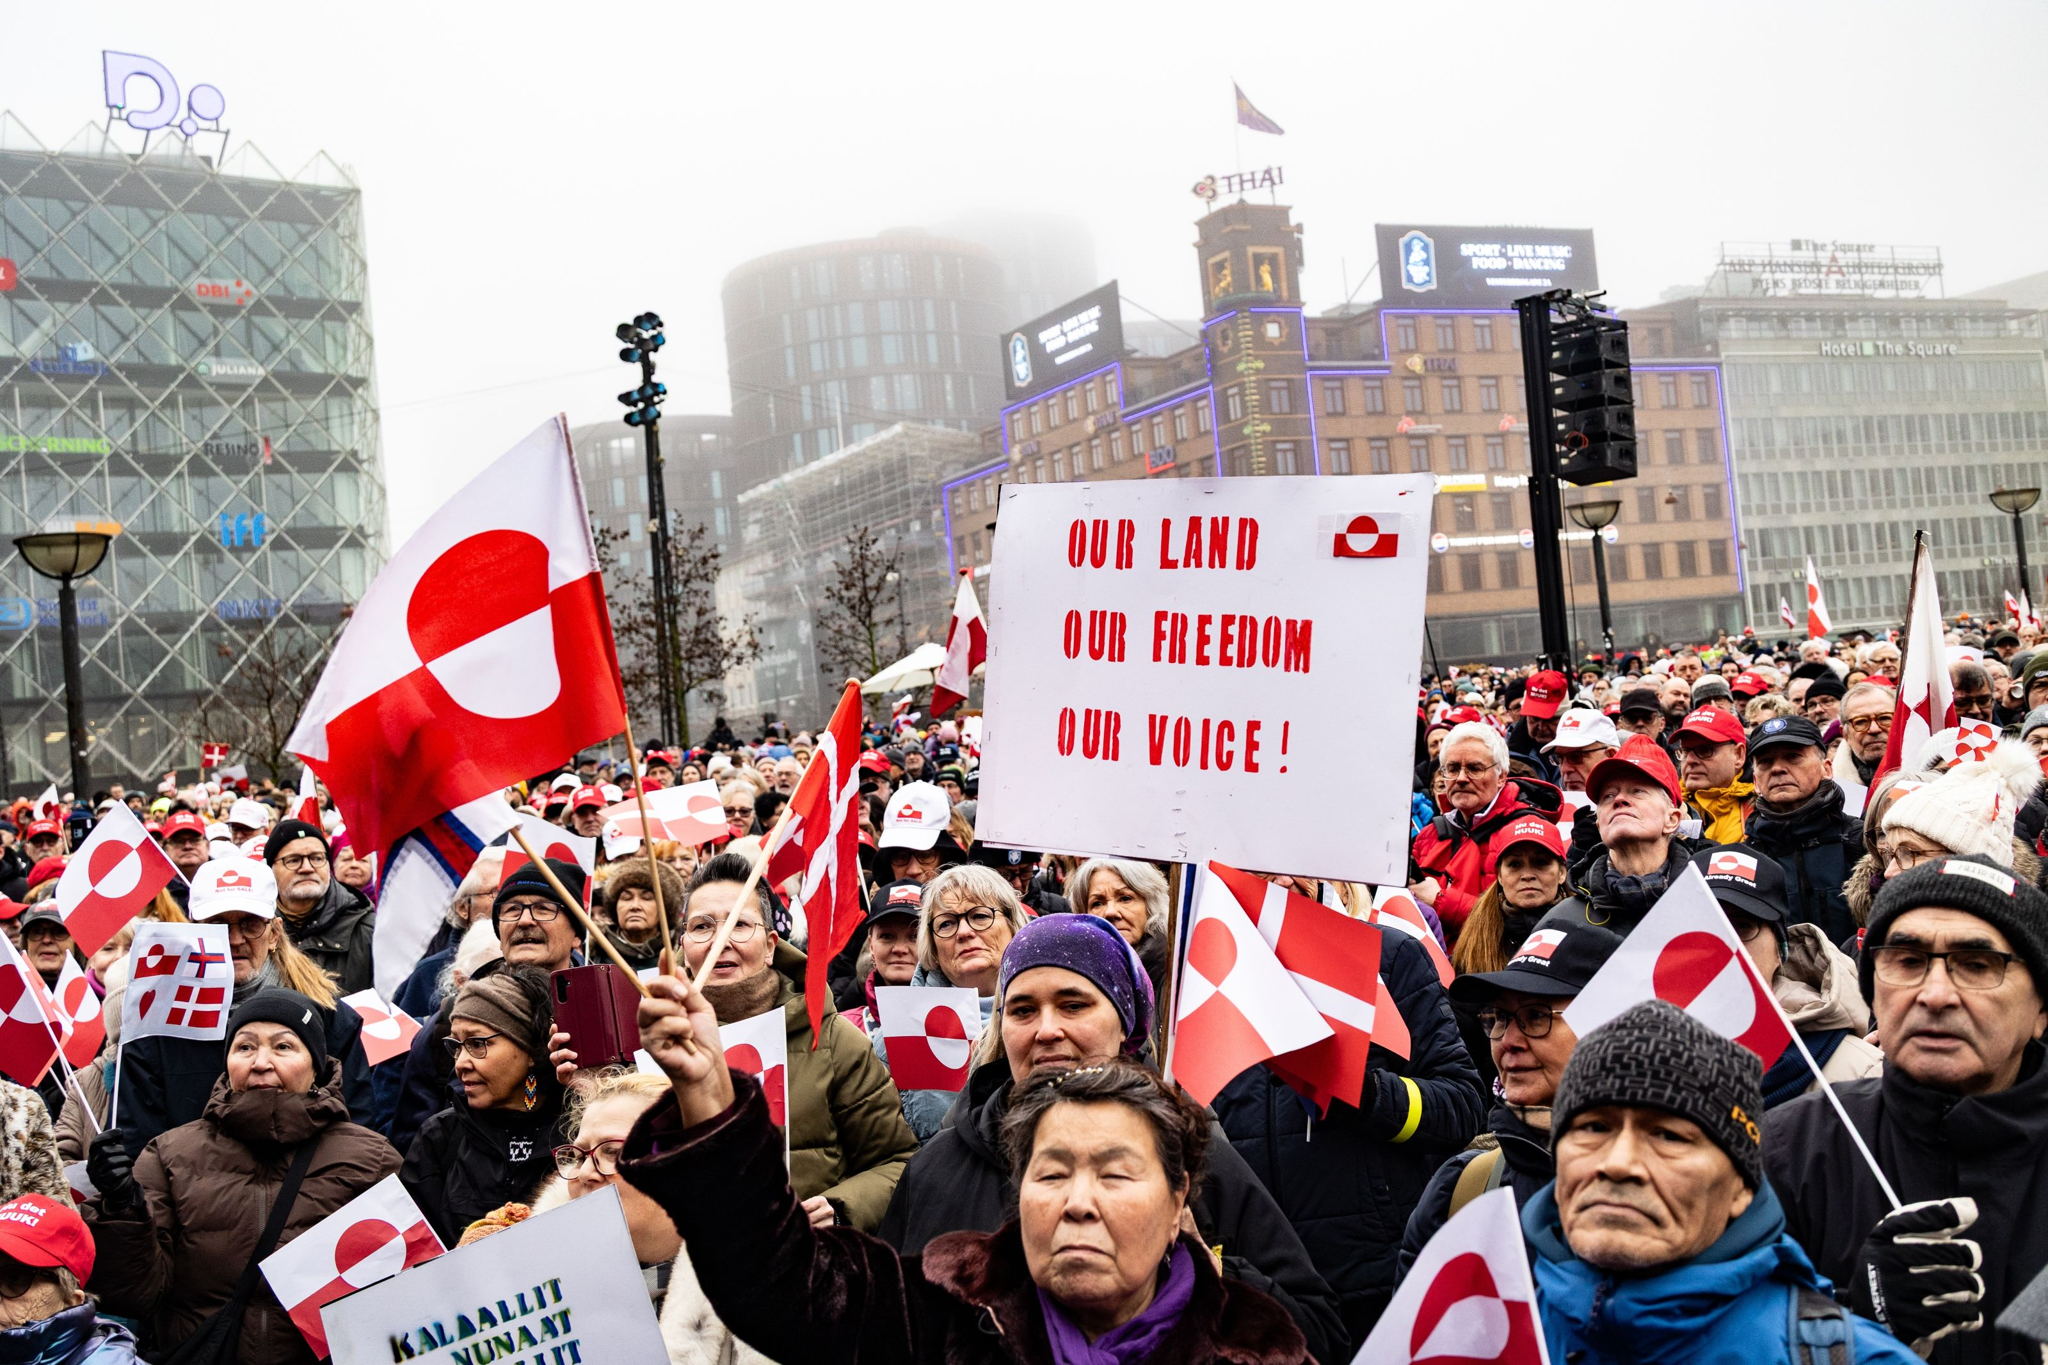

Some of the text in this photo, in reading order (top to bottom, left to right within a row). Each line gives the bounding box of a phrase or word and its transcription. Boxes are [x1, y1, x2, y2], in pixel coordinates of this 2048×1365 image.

[1221, 166, 1283, 193] THAI
[1803, 240, 1875, 254] The Square
[196, 284, 231, 298] DBI
[1820, 341, 1957, 359] Hotel The Square
[211, 364, 267, 376] JULIANA
[205, 442, 260, 457] RESINO
[219, 512, 267, 547] iff
[1068, 516, 1259, 571] OUR LAND
[1063, 609, 1313, 674] OUR FREEDOM
[1057, 707, 1121, 762] OUR
[1529, 822, 1545, 830] det
[1527, 955, 1551, 967] Great
[20, 1201, 47, 1217] det
[0, 1211, 40, 1227] UUK!
[451, 1307, 572, 1365] NUNAAT
